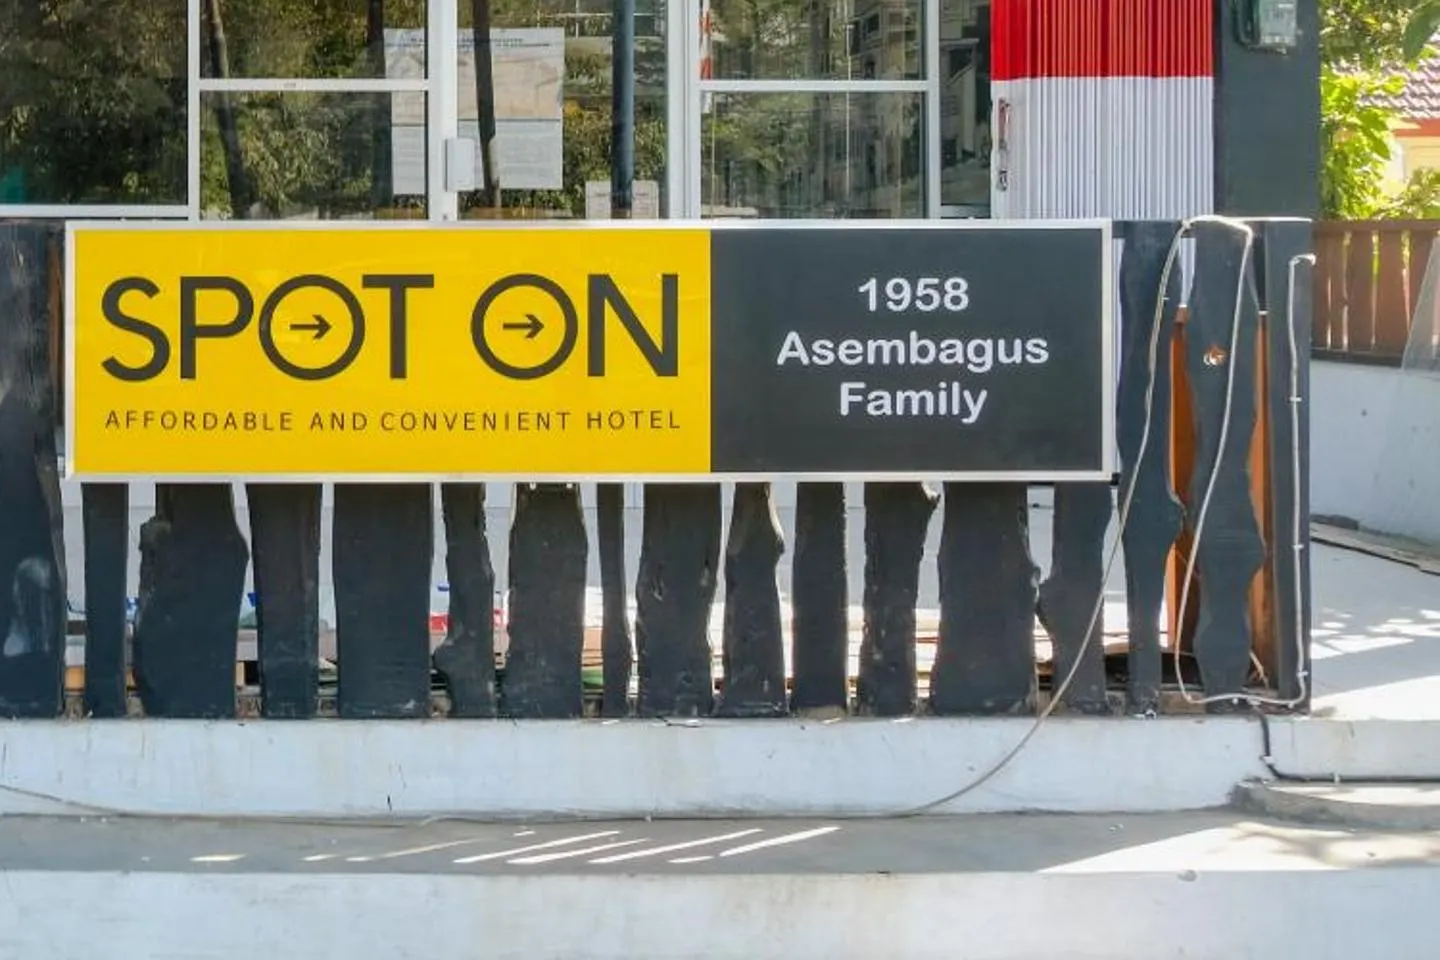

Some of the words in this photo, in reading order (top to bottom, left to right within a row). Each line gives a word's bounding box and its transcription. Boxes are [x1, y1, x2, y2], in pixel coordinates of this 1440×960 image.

[858, 276, 970, 312] 1958
[101, 273, 435, 382] SPOT
[470, 273, 680, 382] ON
[776, 330, 1050, 372] Asembagus
[104, 410, 293, 431] AFFORDABLE
[310, 412, 368, 431] AND
[380, 411, 570, 431] CONVENIENT
[586, 410, 681, 430] HOTEL
[839, 380, 990, 425] Family
